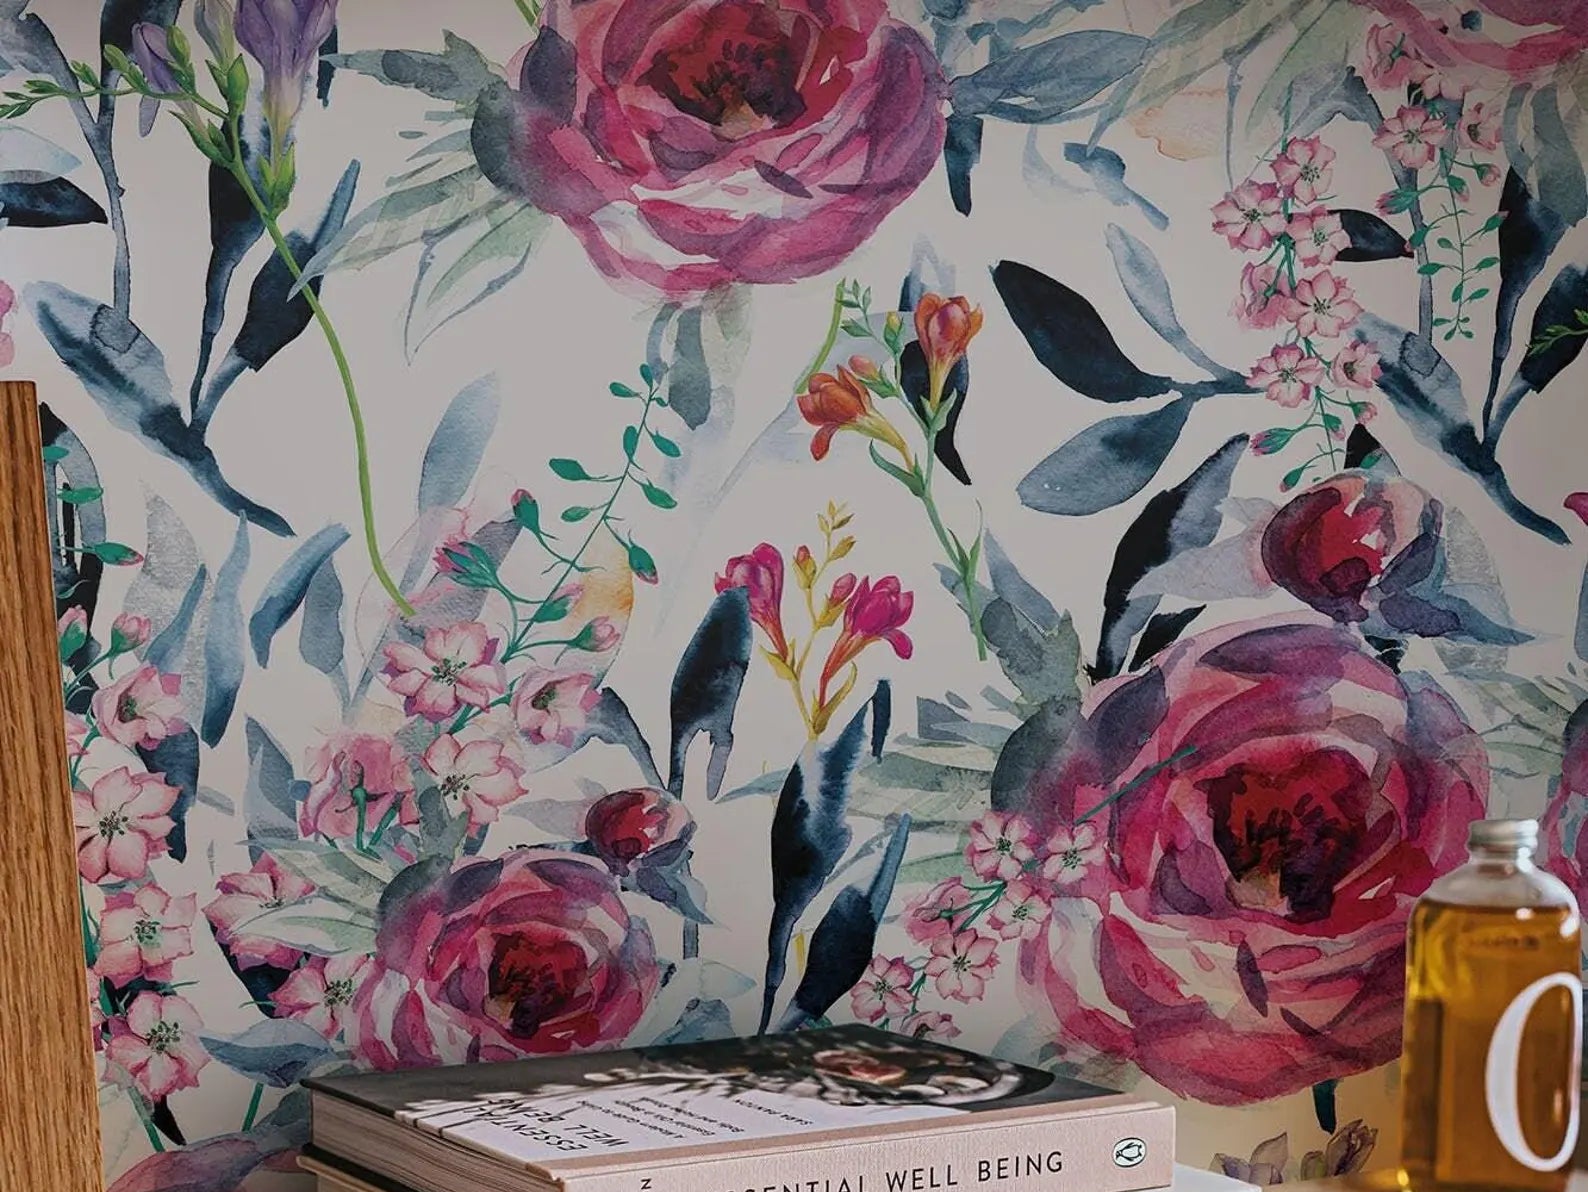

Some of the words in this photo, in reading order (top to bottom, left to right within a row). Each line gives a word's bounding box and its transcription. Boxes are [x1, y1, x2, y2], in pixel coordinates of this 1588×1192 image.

[1486, 972, 1582, 1172] O
[463, 1106, 588, 1151] ESSENTIAL
[563, 1124, 630, 1147] WELL
[978, 1150, 1064, 1183] BEING
